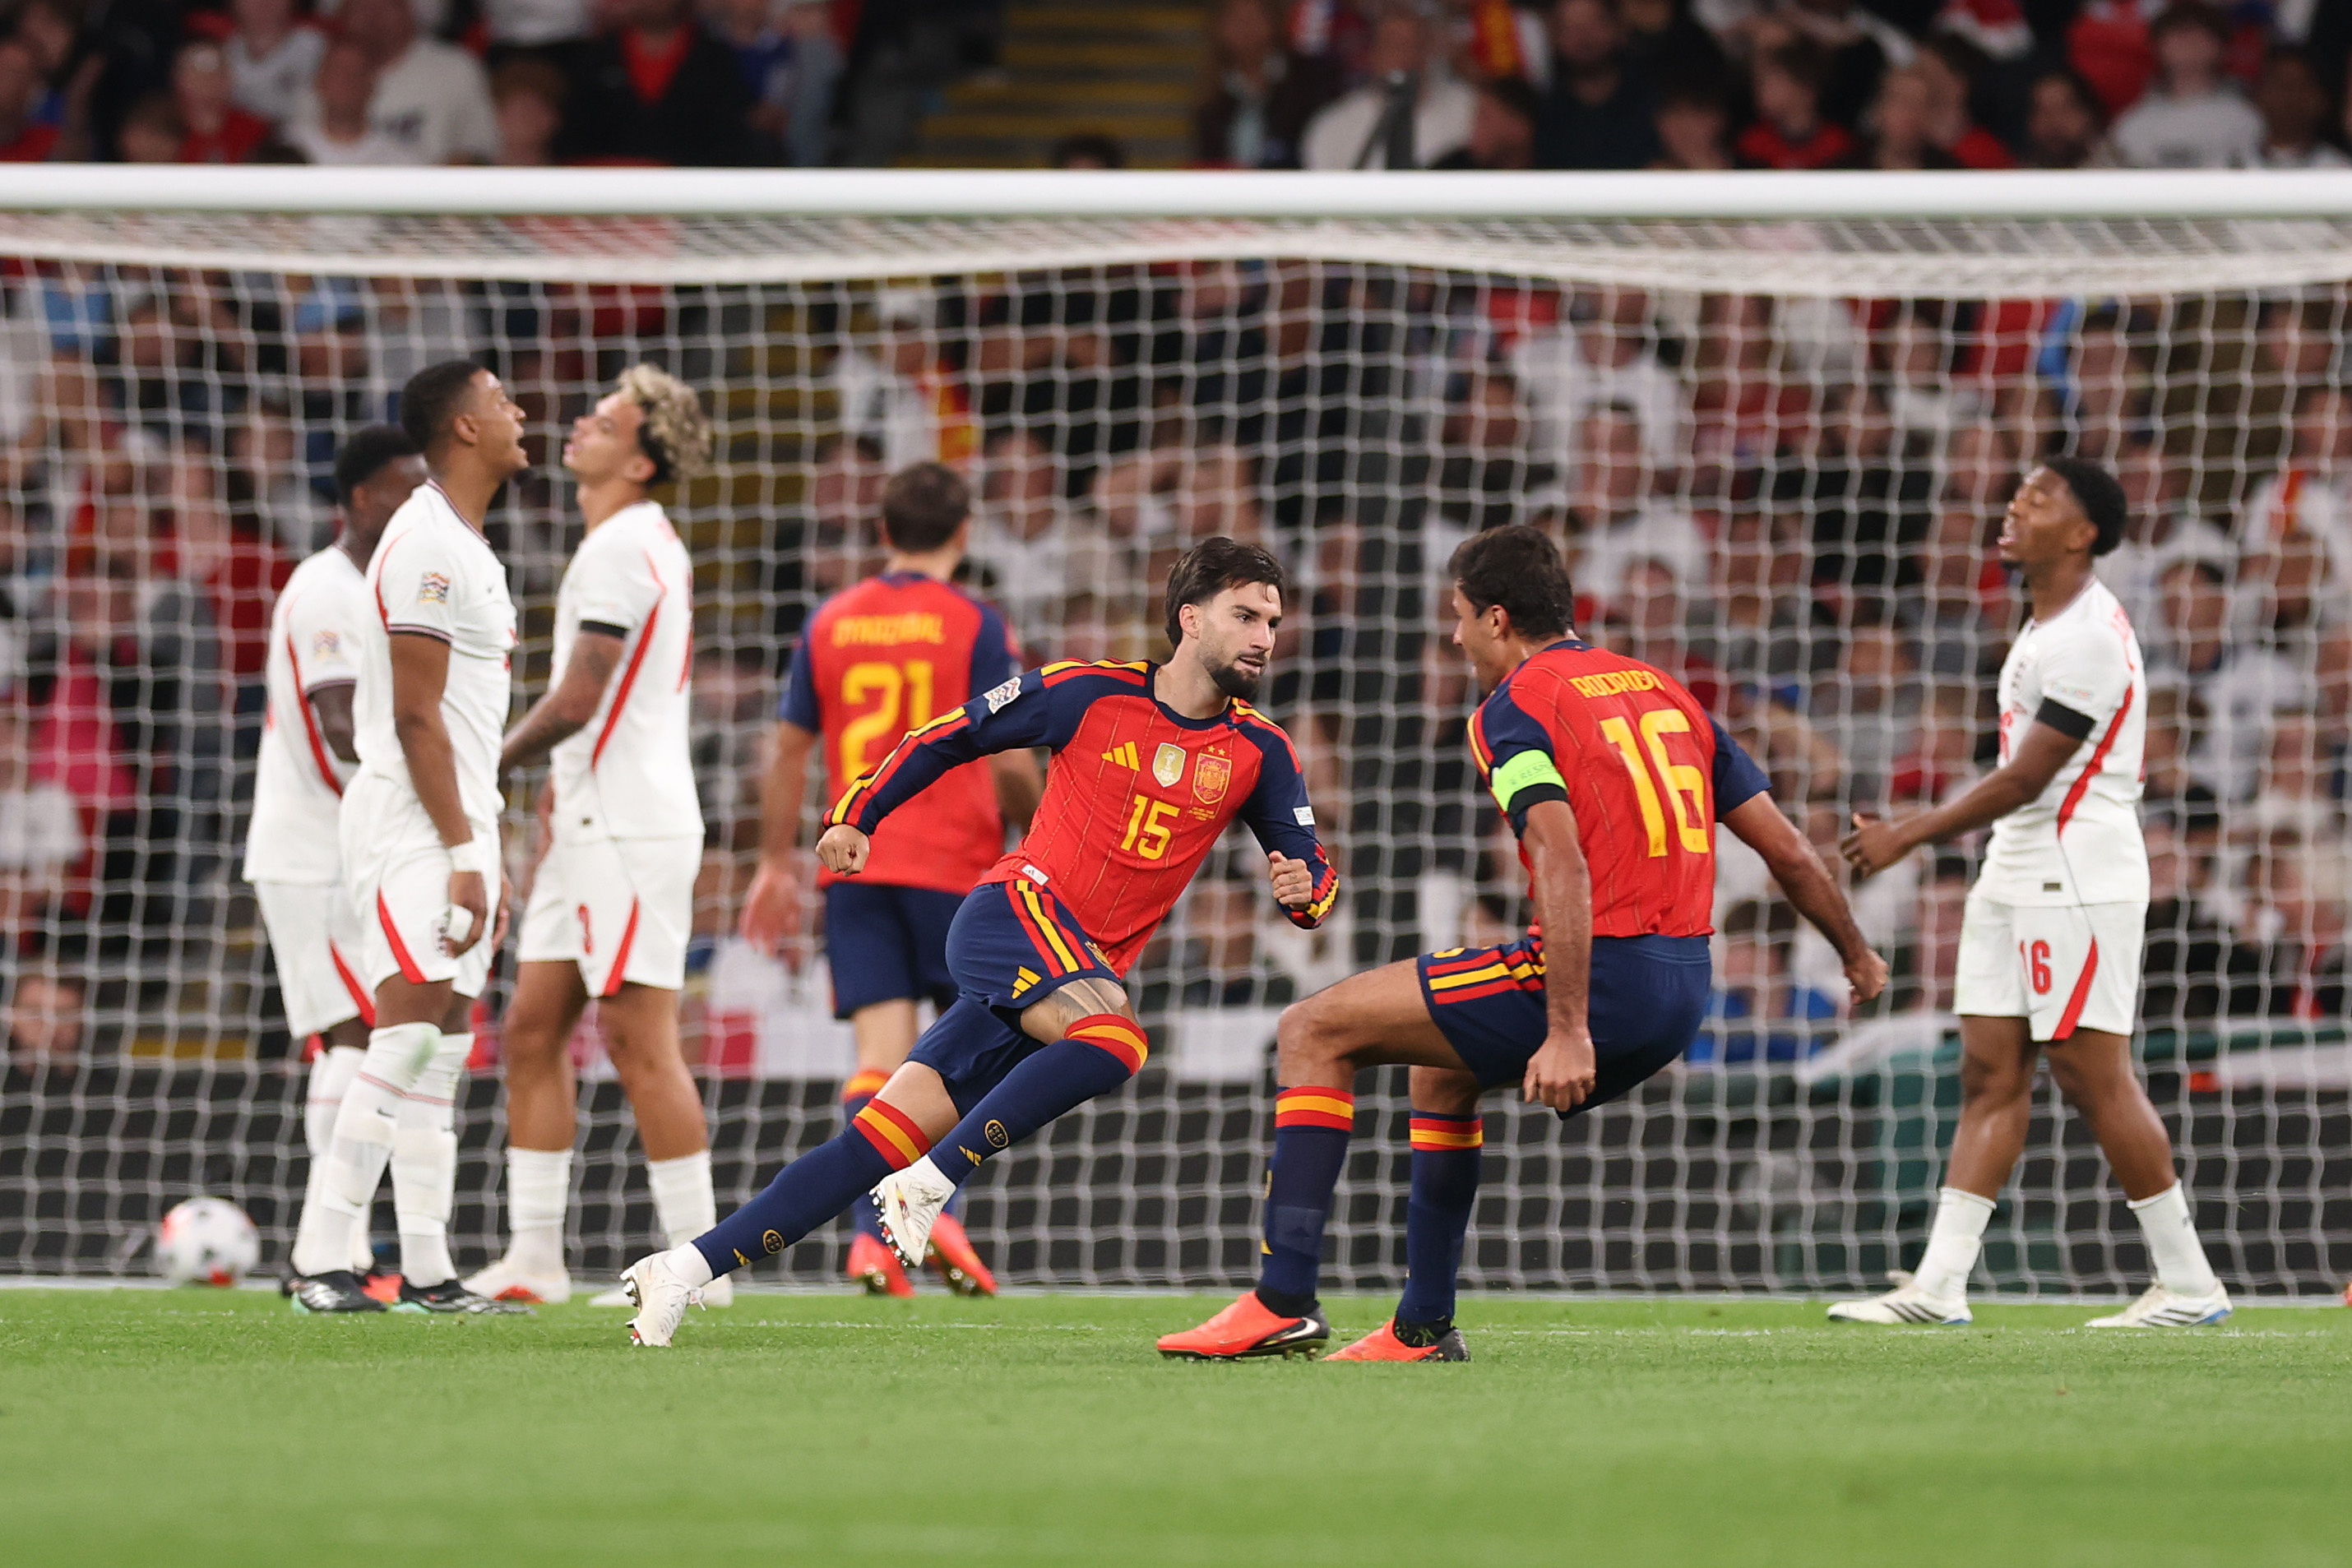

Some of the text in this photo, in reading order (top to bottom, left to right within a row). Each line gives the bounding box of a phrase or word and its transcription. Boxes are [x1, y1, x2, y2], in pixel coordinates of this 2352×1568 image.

[841, 660, 934, 786] 21
[1600, 709, 1710, 857] 16
[1120, 794, 1180, 859] 15
